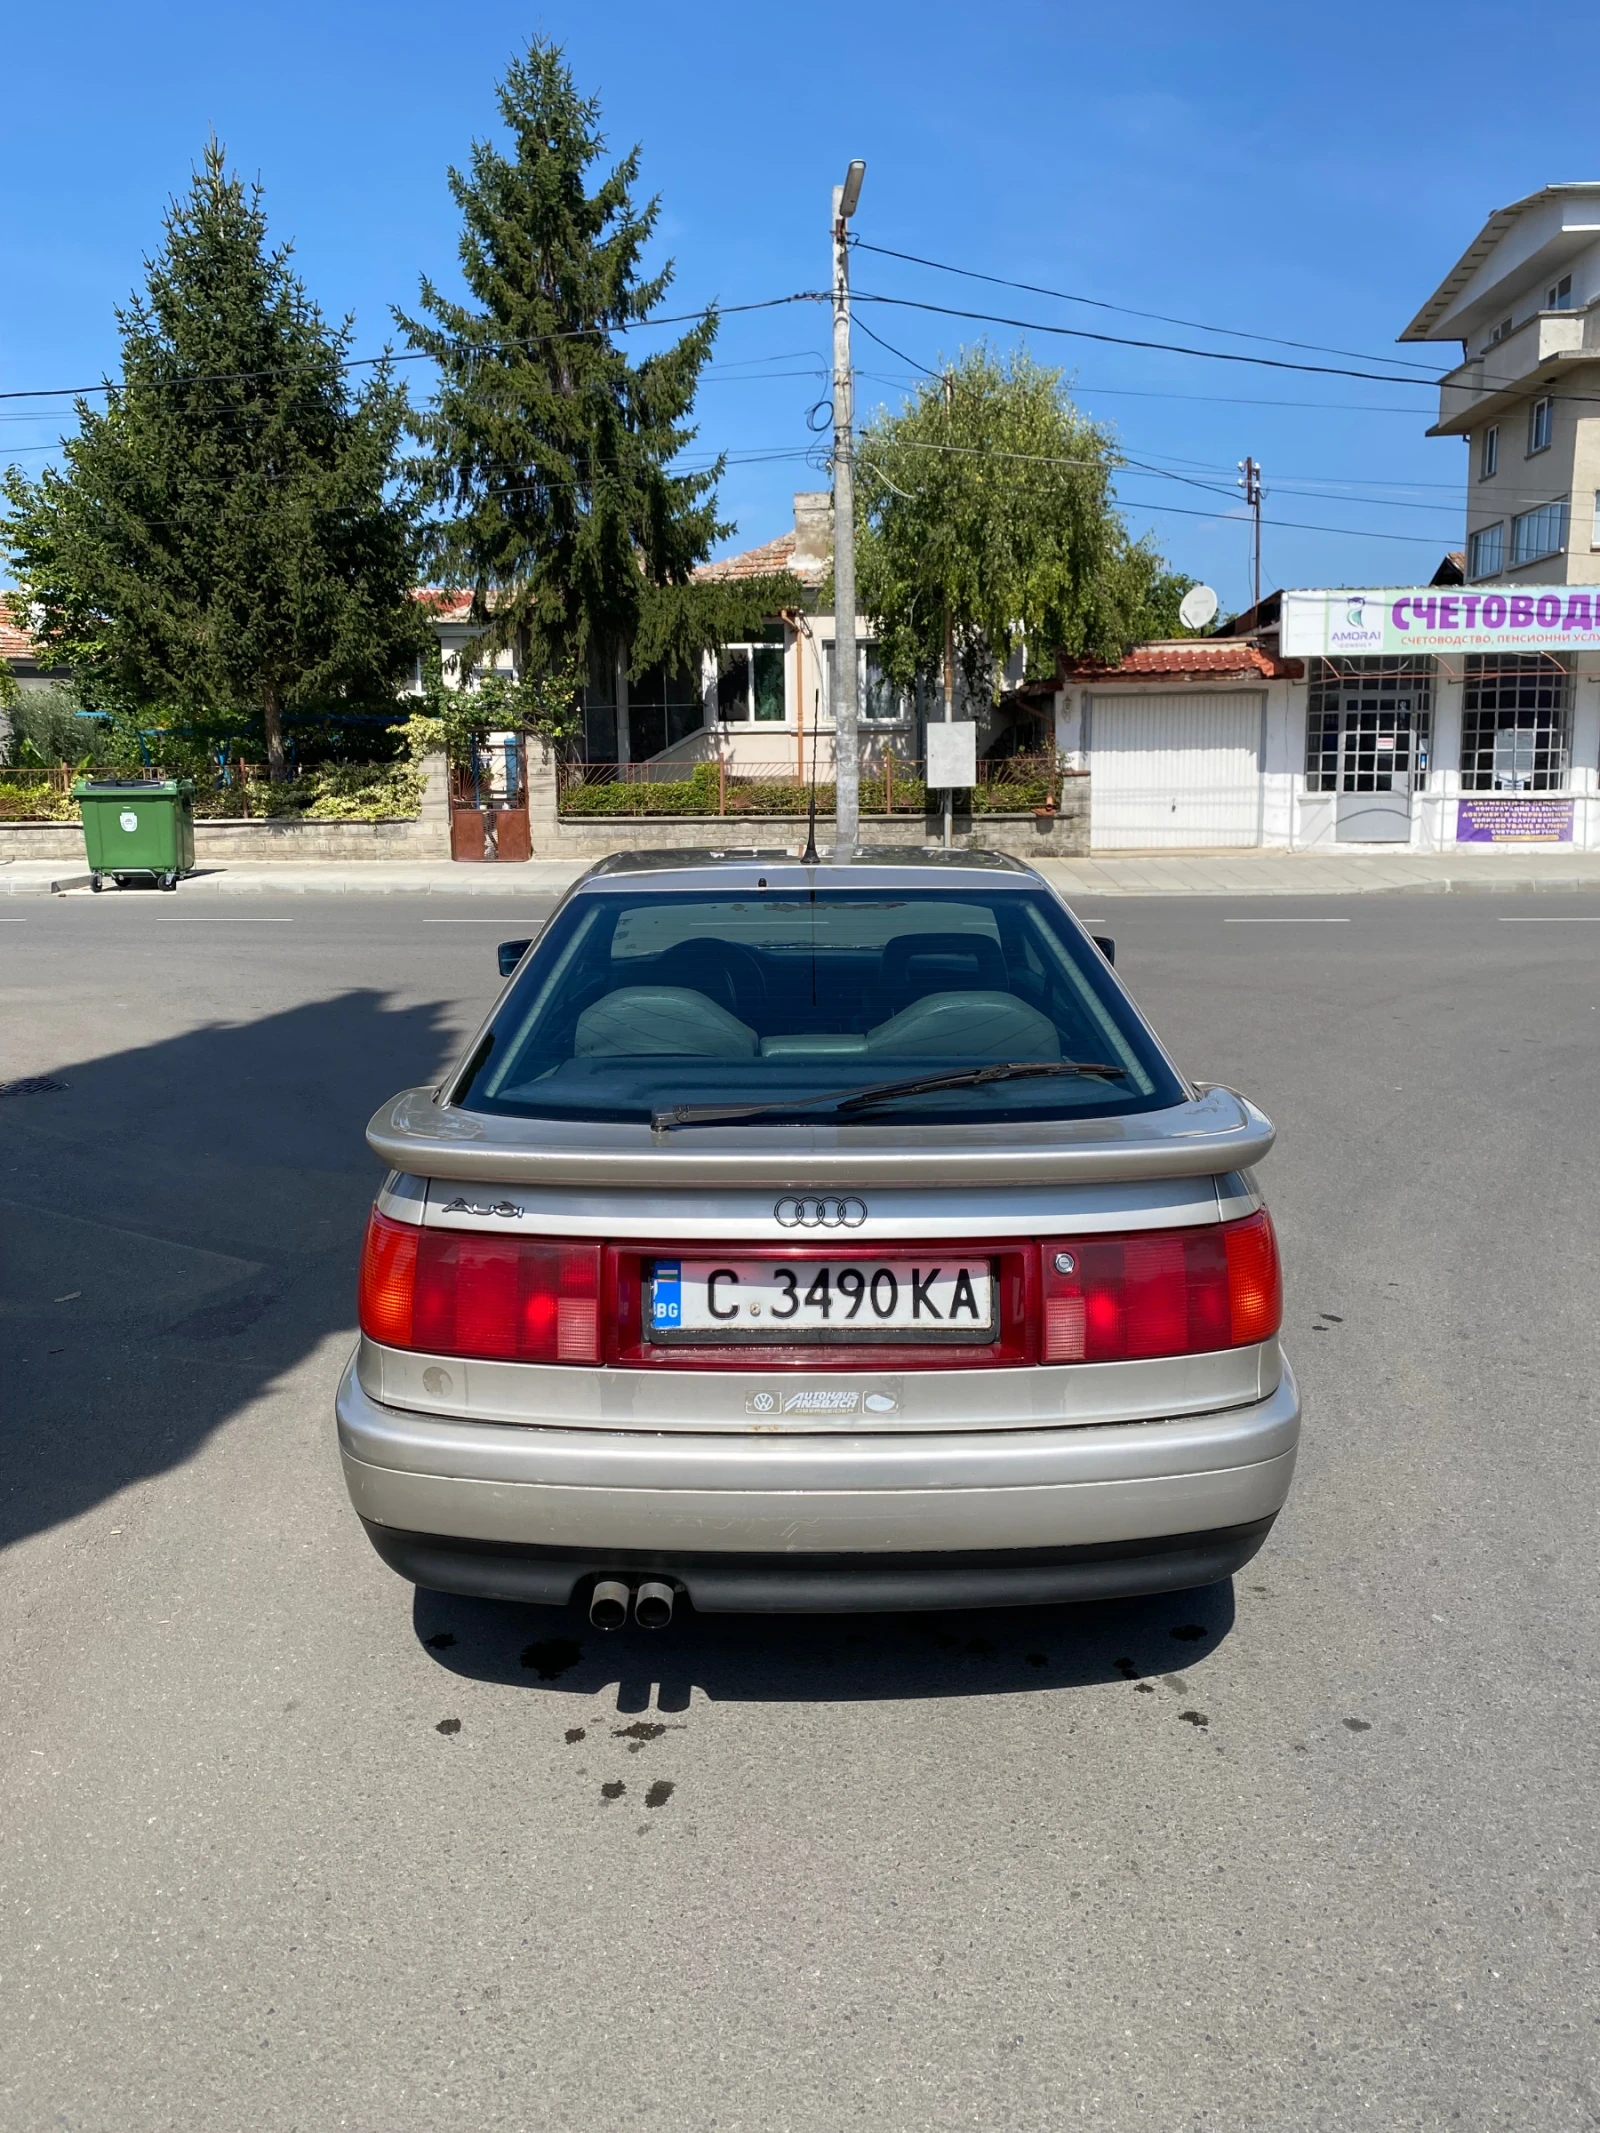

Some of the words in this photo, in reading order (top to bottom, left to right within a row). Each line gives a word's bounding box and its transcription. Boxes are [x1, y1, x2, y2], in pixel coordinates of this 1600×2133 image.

[1331, 631, 1381, 641] AMORAI
[1401, 635, 1494, 645] СЧЕТОВОДСТВО,
[1497, 634, 1570, 643] ПЕНСИОННИ
[442, 1198, 524, 1218] Audi
[707, 1268, 739, 1319] C
[771, 1267, 898, 1319] 3490
[911, 1268, 980, 1319] KA
[656, 1302, 679, 1318] BG
[785, 1391, 860, 1404] AUTOHAUS
[785, 1400, 856, 1411] ANSBACH
